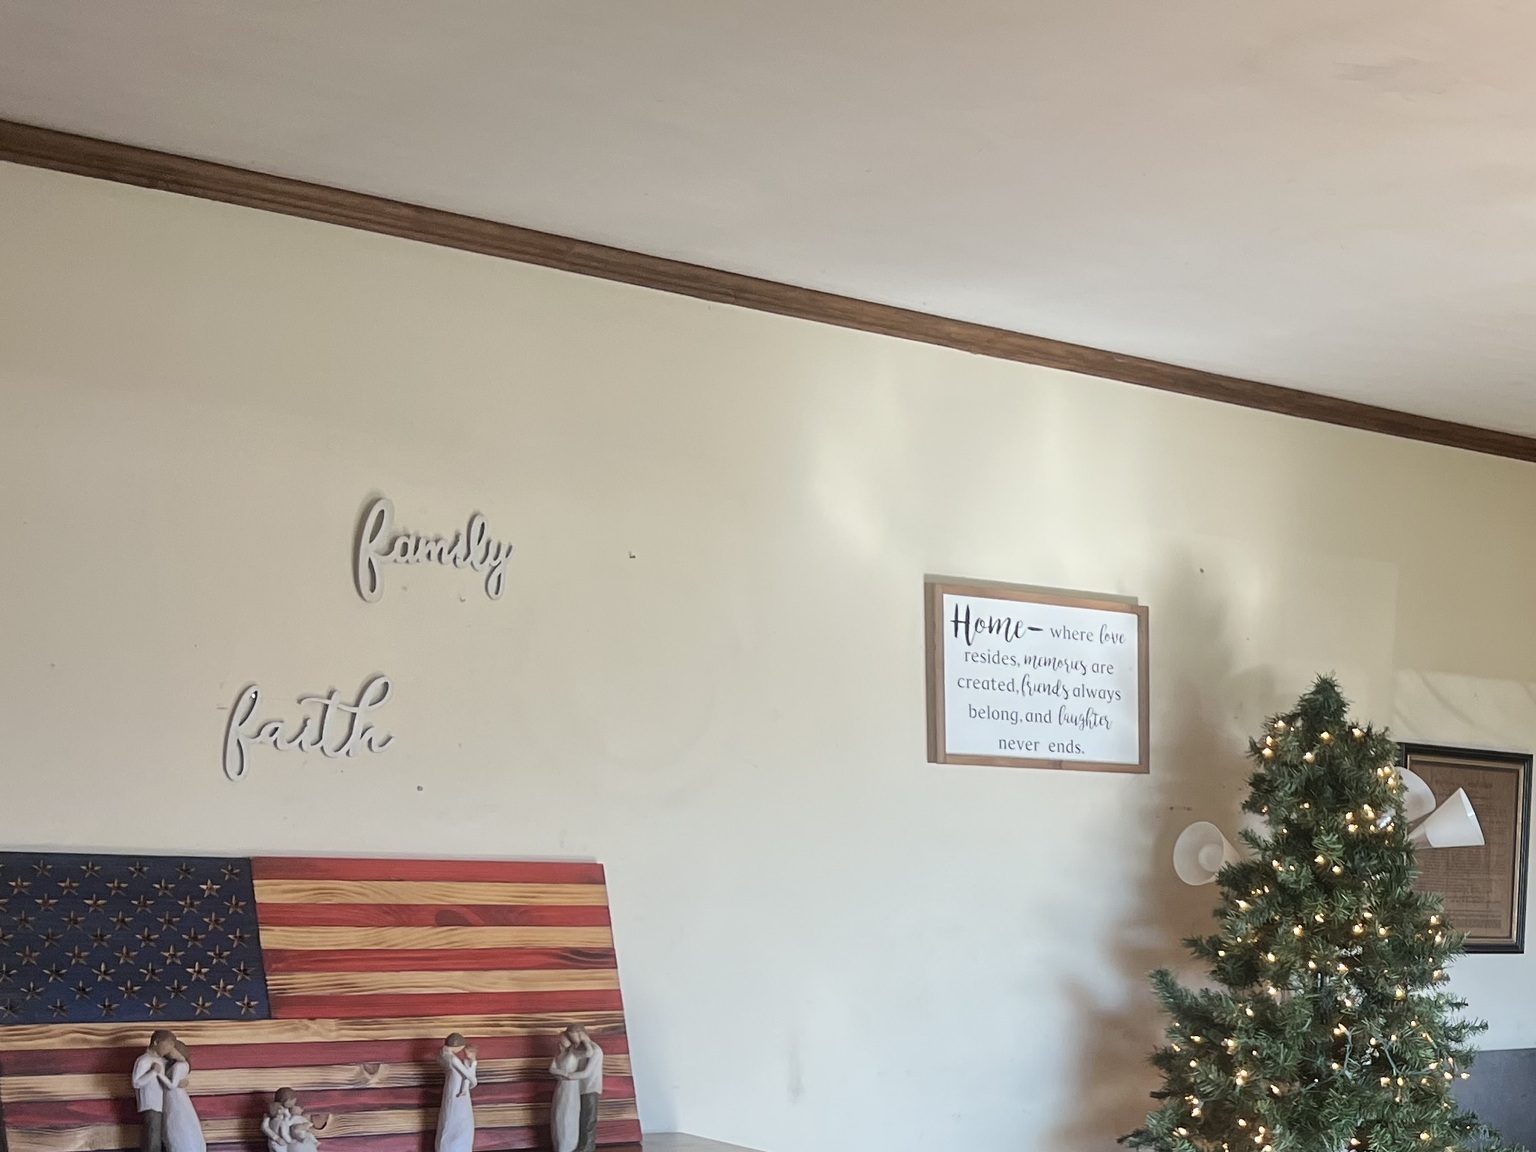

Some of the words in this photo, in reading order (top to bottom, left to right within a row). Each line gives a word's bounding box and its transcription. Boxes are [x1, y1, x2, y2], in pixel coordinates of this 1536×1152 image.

[353, 497, 513, 603] family
[1049, 624, 1095, 642] where
[1099, 623, 1127, 645] love
[963, 648, 1021, 668] resides,
[1023, 653, 1088, 676] memories
[1091, 662, 1115, 675] are
[956, 675, 1020, 694] created,
[1020, 673, 1070, 701] friends
[1072, 686, 1122, 703] always
[222, 672, 395, 782] faith
[968, 704, 1023, 725] belong,
[1025, 709, 1053, 724] and
[1057, 704, 1113, 731] laughter
[998, 737, 1041, 752] never
[1047, 739, 1086, 755] ends.
